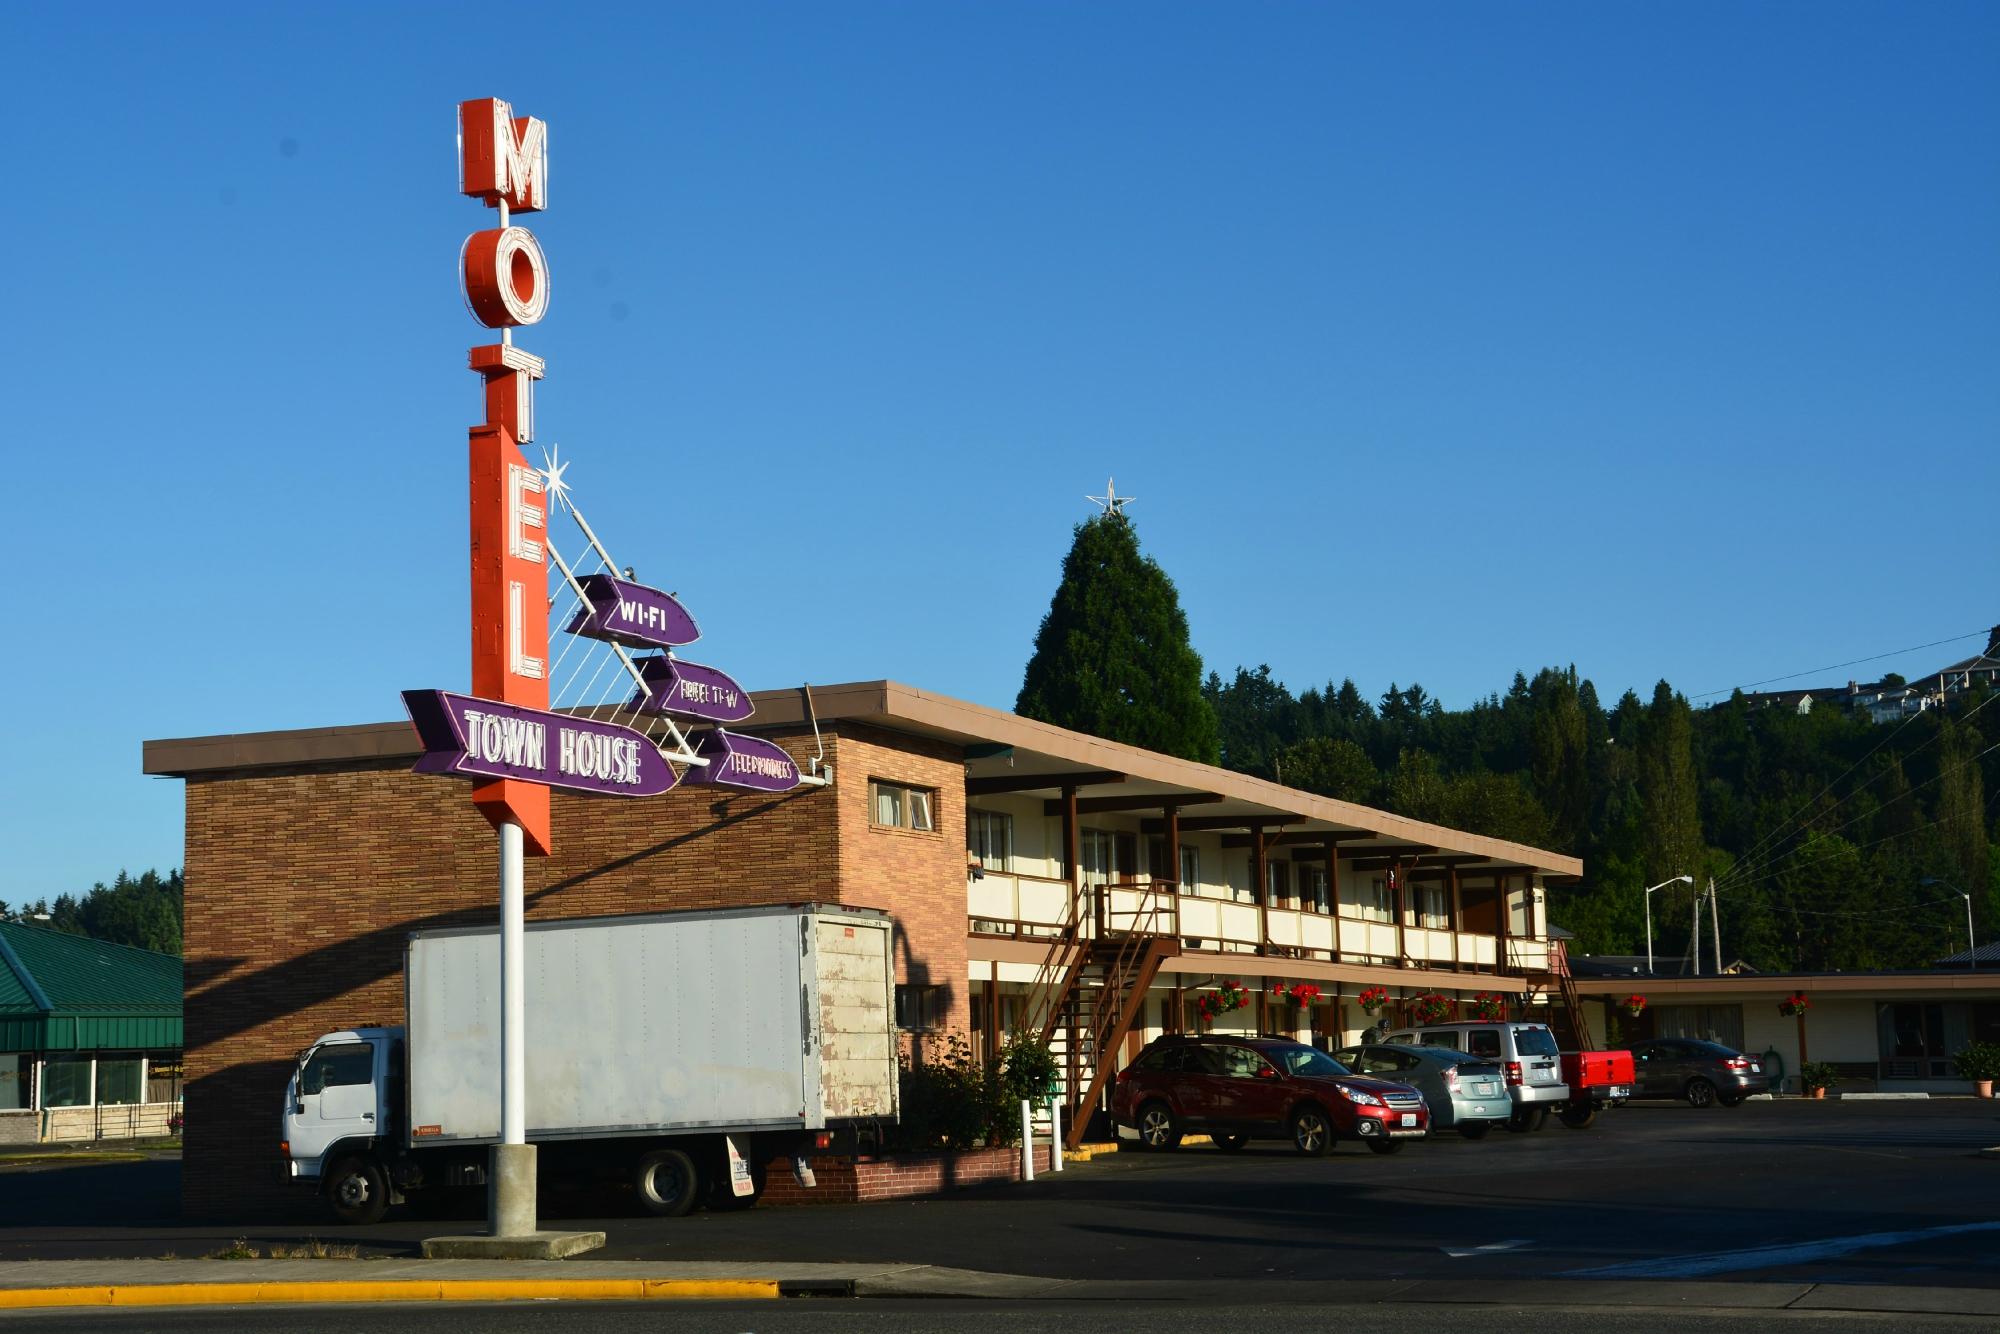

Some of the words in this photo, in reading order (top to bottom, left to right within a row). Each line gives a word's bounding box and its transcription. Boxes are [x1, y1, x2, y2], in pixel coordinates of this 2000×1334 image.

[490, 97, 550, 680] MOTEL
[620, 600, 666, 631] WI-FI
[680, 679, 710, 704] FREE
[464, 709, 546, 772] TOWN
[559, 728, 642, 785] HOUSE
[730, 752, 792, 780] TELEPHONES
